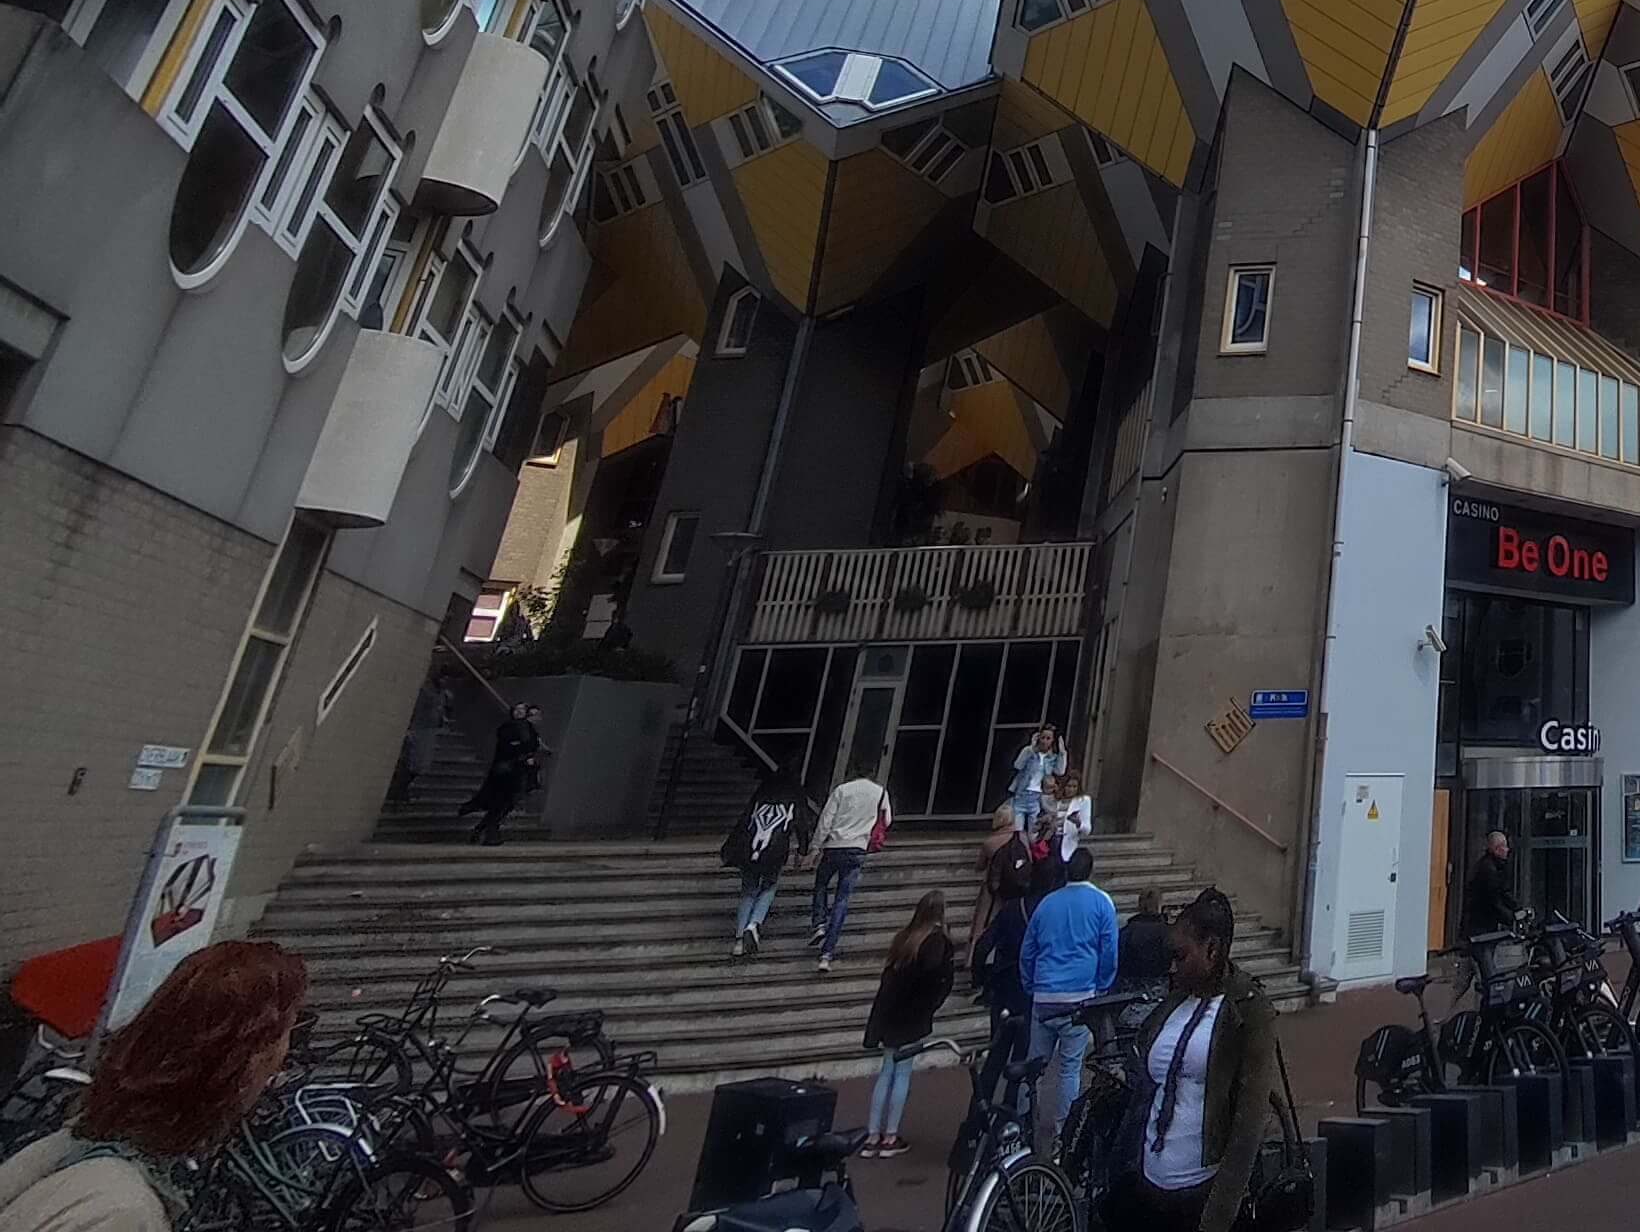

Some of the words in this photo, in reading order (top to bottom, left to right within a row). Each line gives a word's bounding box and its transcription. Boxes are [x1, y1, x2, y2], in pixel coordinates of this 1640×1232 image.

[1453, 499, 1499, 522] CASINO
[1497, 526, 1540, 573] Be
[1547, 534, 1609, 582] One
